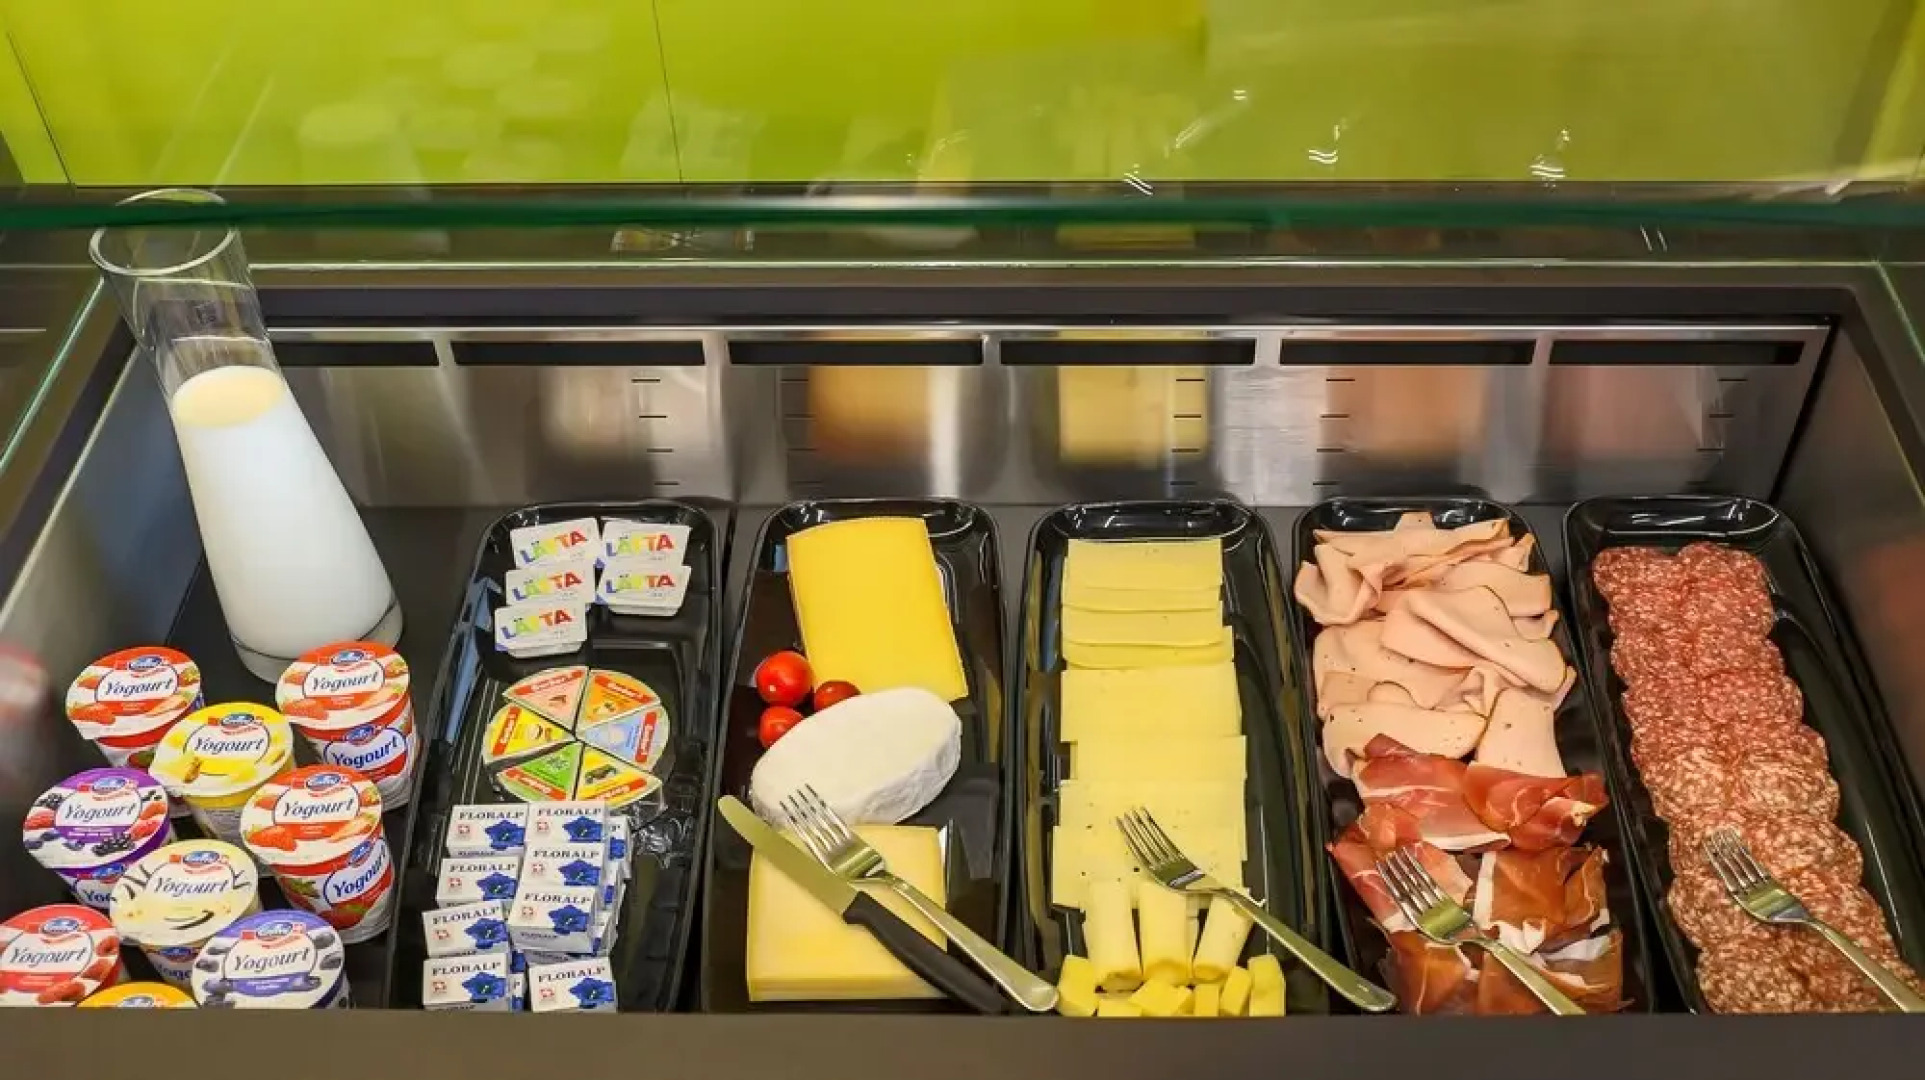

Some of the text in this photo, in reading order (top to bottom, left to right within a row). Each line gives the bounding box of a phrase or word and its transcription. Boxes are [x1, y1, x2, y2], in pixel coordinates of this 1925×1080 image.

[105, 678, 174, 697] Yogourt
[312, 671, 378, 691] Yogourt
[194, 737, 264, 755] Yogourt
[331, 735, 398, 769] Yogourt
[65, 802, 136, 822] Yogourt
[283, 798, 354, 820] Yogourt
[459, 811, 524, 820] FLORALP
[537, 808, 602, 817] FLORALP
[533, 850, 600, 859] FLORALP
[449, 863, 516, 873] FLORALP
[154, 877, 229, 897] Yogourt
[524, 892, 592, 904] FLORALP
[432, 905, 501, 925] FLORALP
[10, 946, 87, 967] Yogourt
[235, 947, 309, 973] Yogourt
[432, 961, 501, 976] FLORALP
[538, 967, 606, 983] FLORALP
